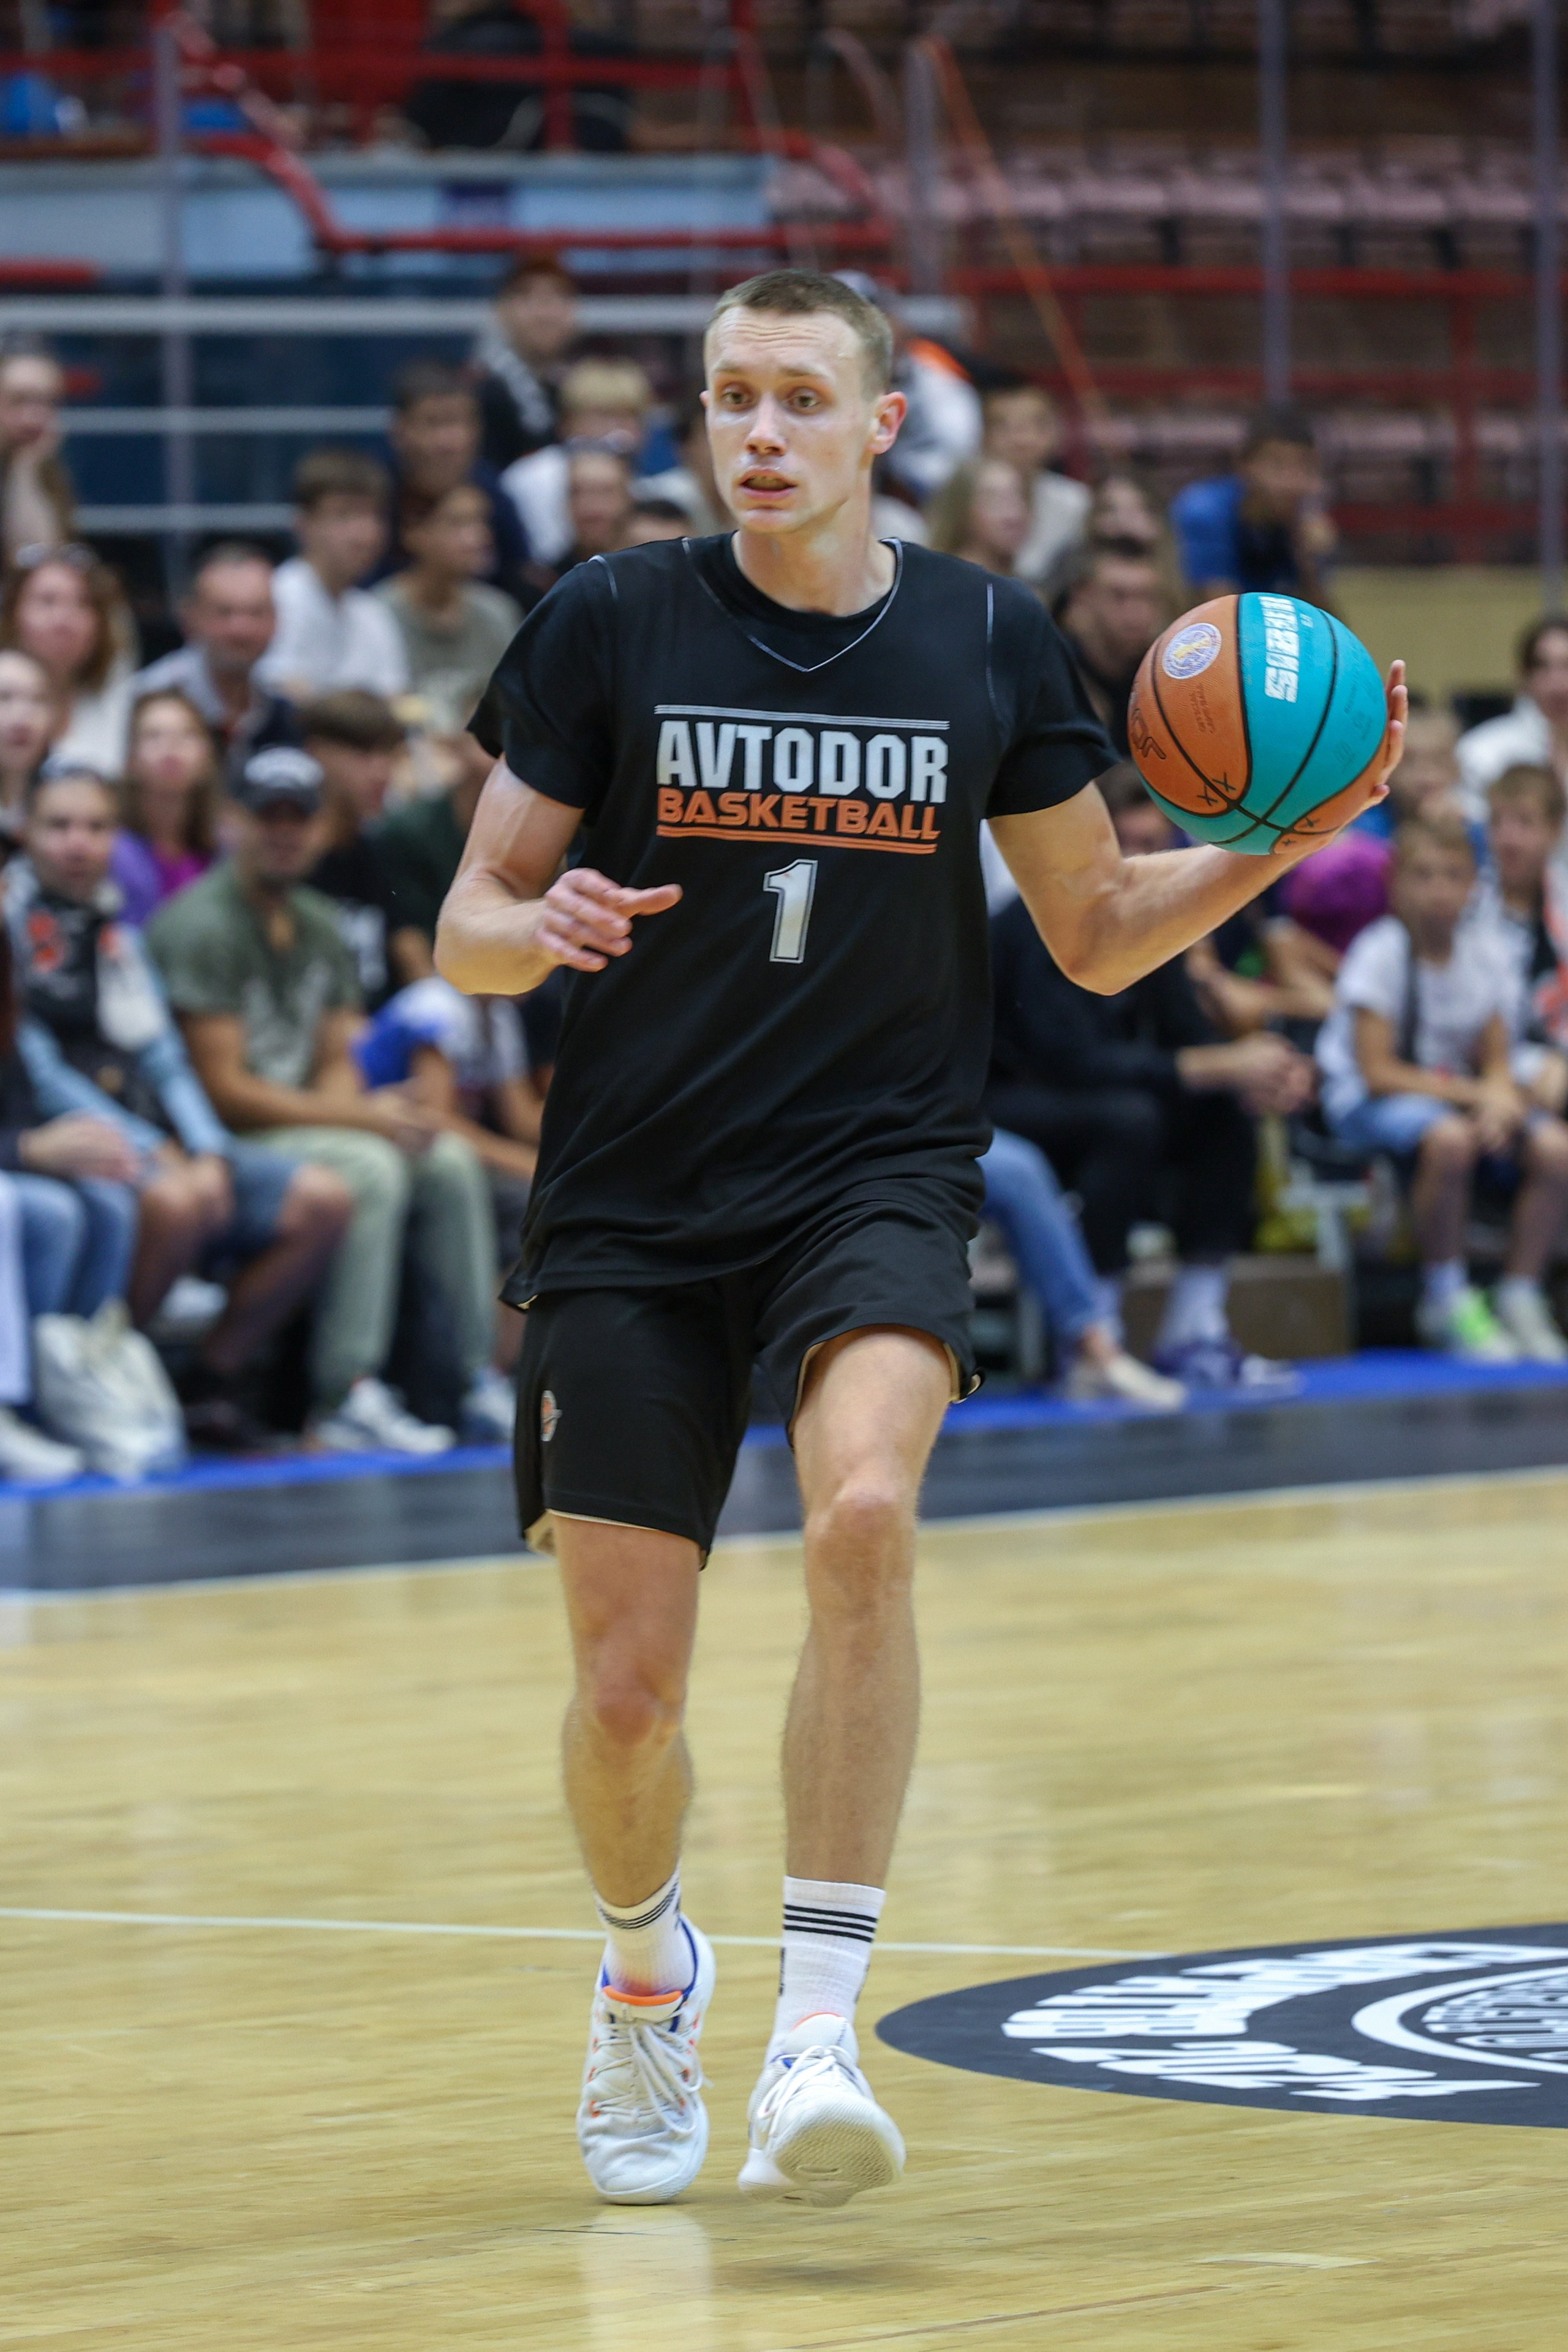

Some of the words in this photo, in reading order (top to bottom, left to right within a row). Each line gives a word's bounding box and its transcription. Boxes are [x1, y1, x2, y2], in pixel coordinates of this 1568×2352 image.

[656, 720, 949, 804] AVTODOR
[657, 786, 941, 840] BASKETBALL
[763, 858, 818, 964] 1
[1031, 2040, 1542, 2101] 2024
